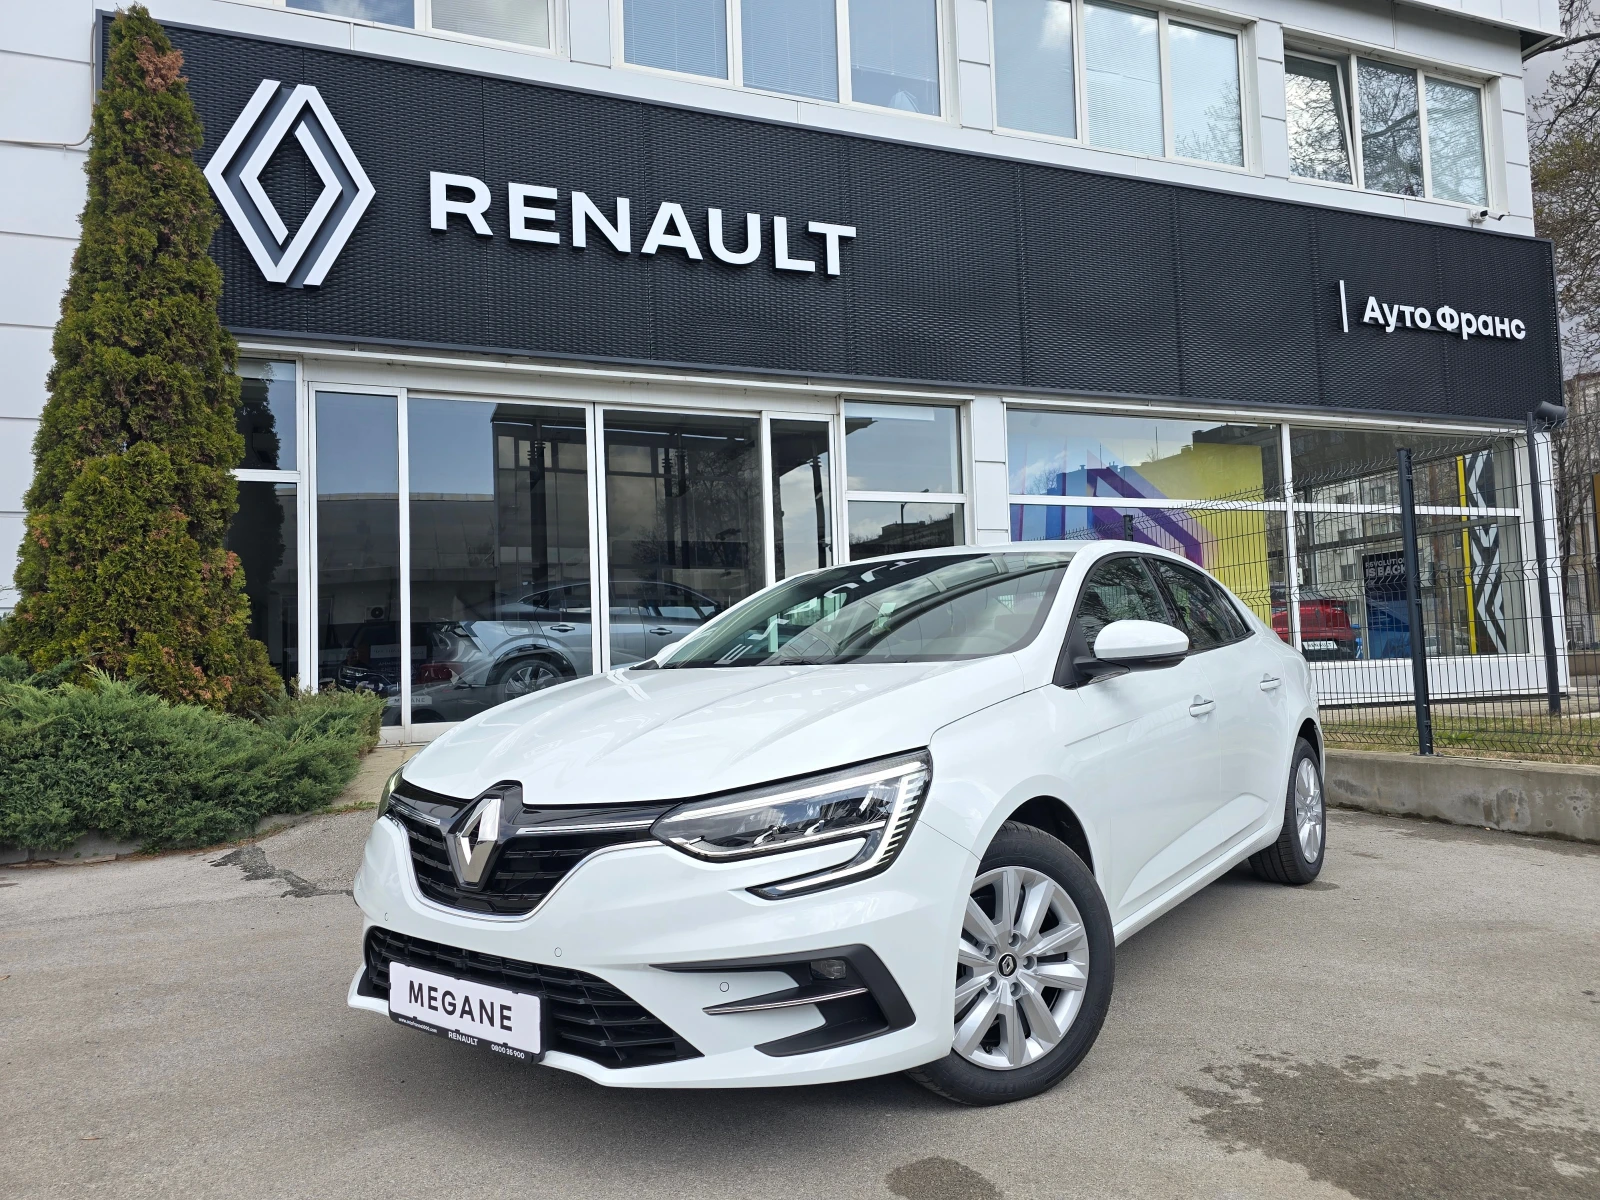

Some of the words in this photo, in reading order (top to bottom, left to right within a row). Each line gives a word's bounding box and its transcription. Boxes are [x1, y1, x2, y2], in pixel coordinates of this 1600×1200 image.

[429, 171, 857, 276] RENAULT
[1363, 296, 1432, 332] Ауто
[1436, 305, 1526, 340] Франс
[1365, 568, 1376, 577] IS
[1378, 564, 1406, 576] BACK
[408, 980, 513, 1032] MEGANE
[448, 1031, 479, 1046] RENAULT
[513, 1050, 525, 1059] 900
